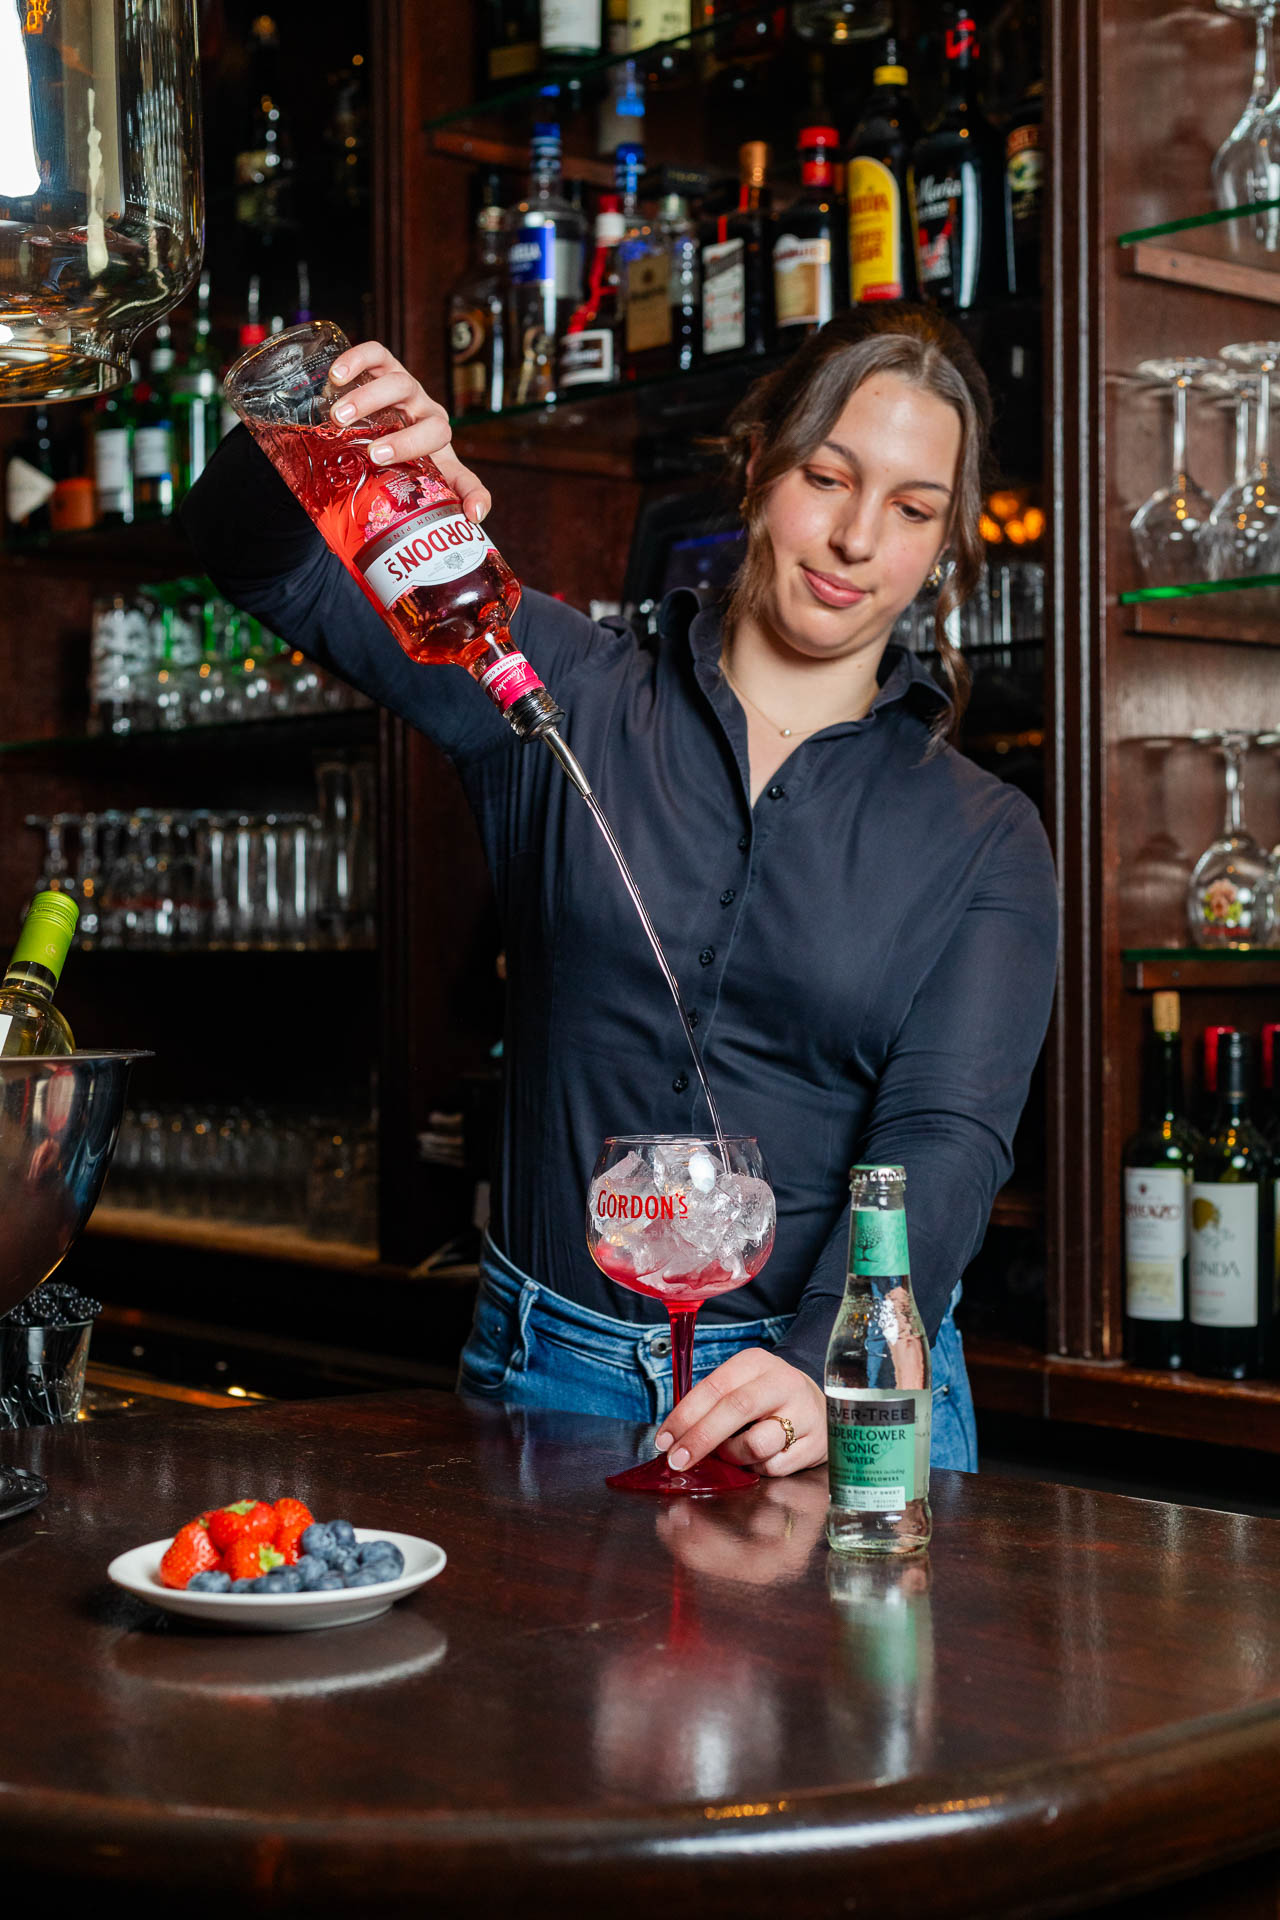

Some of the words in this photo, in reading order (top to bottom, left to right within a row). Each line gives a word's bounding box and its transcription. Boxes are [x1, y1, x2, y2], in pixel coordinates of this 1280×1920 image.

[386, 524, 413, 545] PINK
[383, 517, 486, 583] GORDON'S
[597, 1189, 689, 1219] GORDON'S
[829, 1427, 906, 1442] LDERFLOWER
[842, 1443, 880, 1455] TONIC
[846, 1456, 876, 1465] WATER
